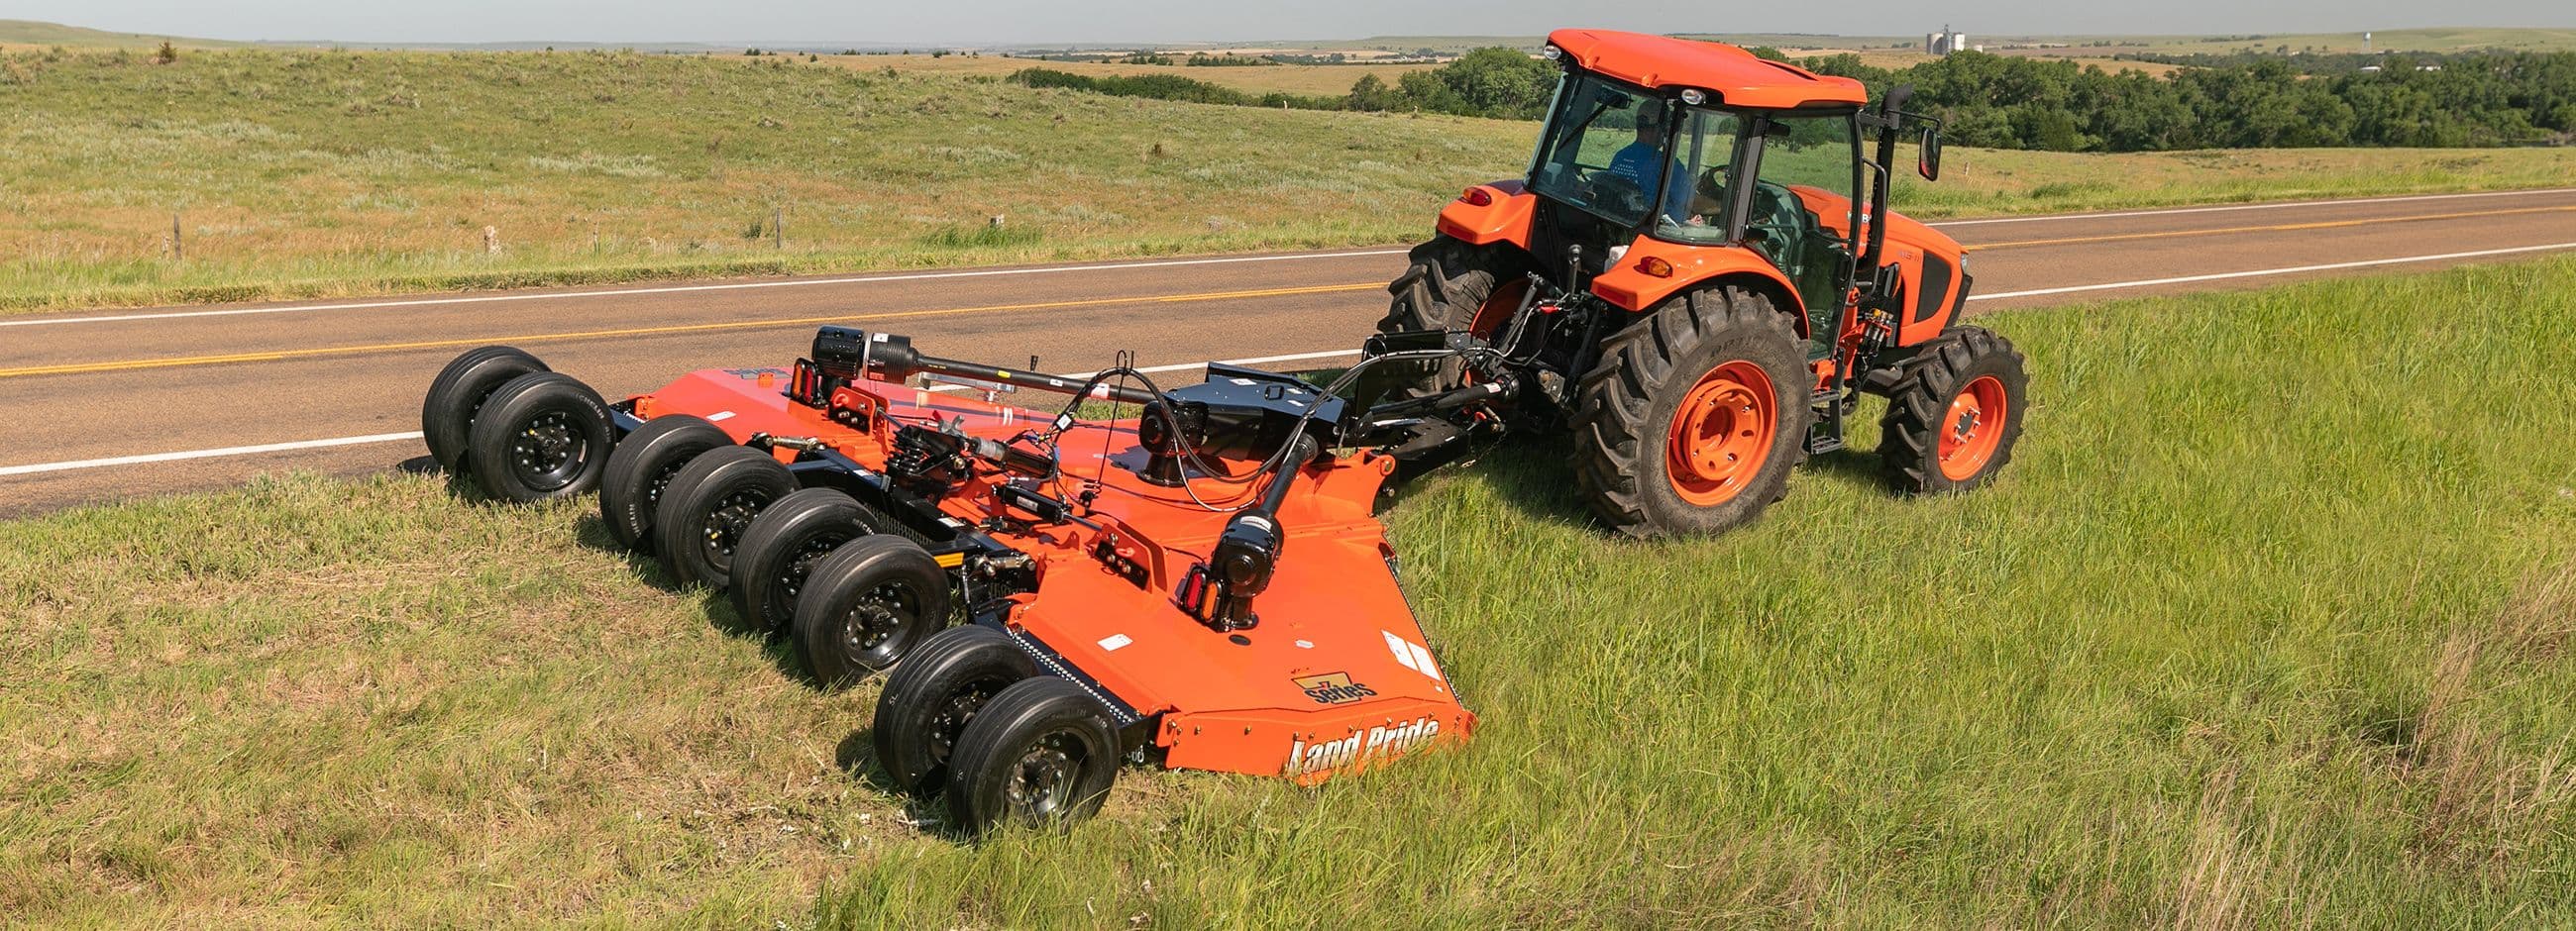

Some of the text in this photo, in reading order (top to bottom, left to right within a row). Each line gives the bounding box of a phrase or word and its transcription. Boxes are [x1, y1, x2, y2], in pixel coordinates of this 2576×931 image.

[1304, 682, 1378, 704] Series
[1288, 716, 1441, 776] Land Pride
